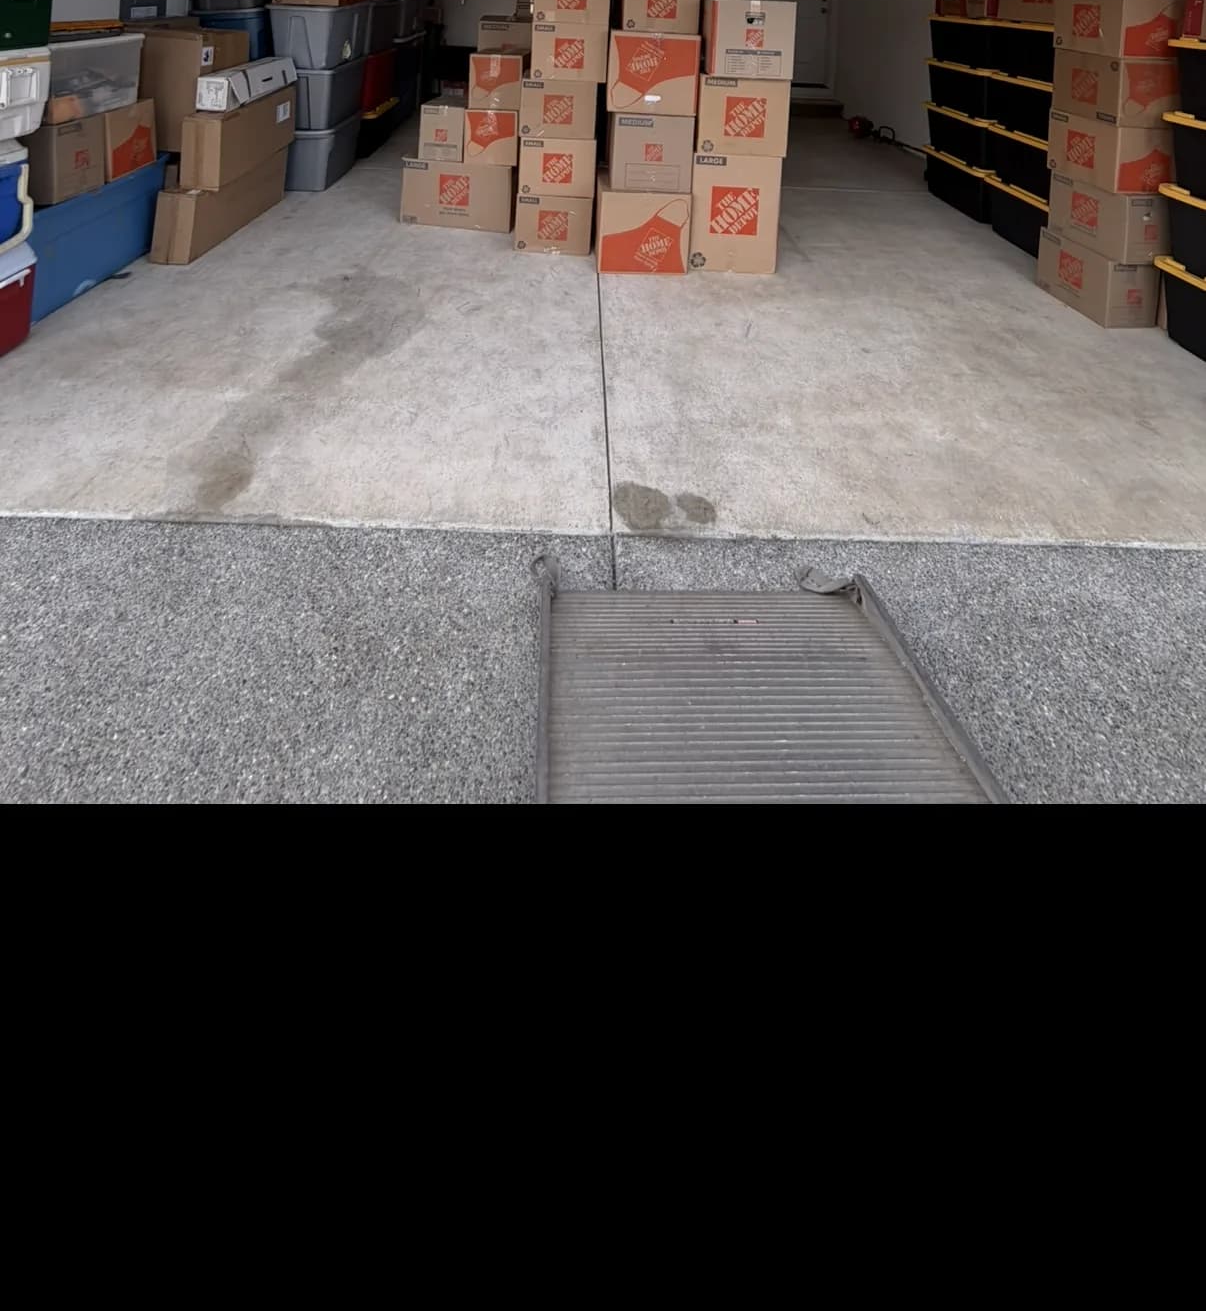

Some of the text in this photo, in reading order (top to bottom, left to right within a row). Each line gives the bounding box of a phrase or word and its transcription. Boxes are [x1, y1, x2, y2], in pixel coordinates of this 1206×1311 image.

[553, 40, 583, 68] HOME
[543, 96, 572, 123] HOME
[725, 98, 766, 136] HOME
[731, 102, 745, 116] THE
[740, 113, 766, 137] DEPOT
[406, 161, 426, 169] LARGE
[542, 155, 572, 183] HOME
[700, 156, 723, 164] LARGE
[439, 176, 468, 205] HOME
[718, 192, 736, 209] THE
[710, 188, 759, 234] HOME
[728, 205, 759, 234] DEPOT
[537, 212, 567, 240] HOME
[640, 238, 668, 253] HOME
